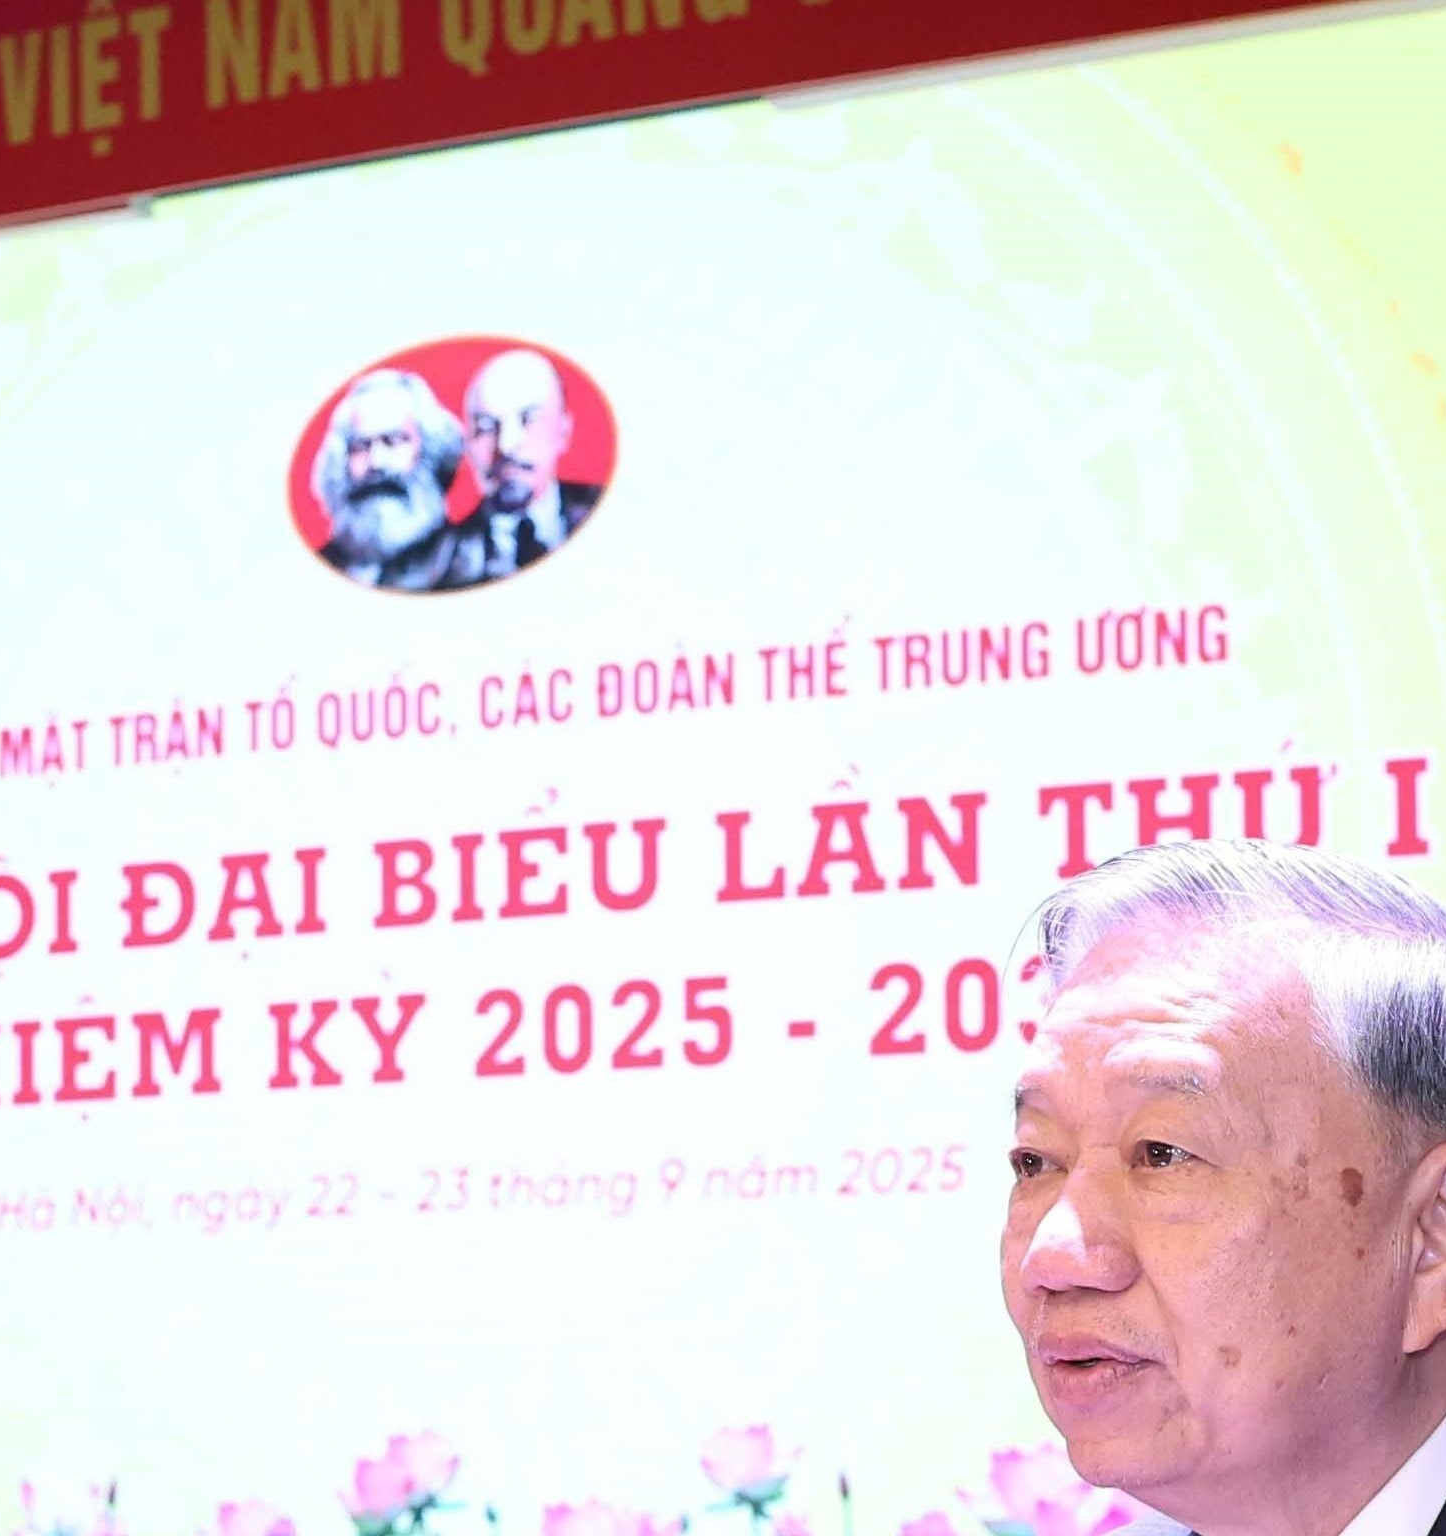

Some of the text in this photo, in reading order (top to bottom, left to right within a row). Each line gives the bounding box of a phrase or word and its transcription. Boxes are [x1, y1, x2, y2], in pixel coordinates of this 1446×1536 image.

[206, 0, 403, 110] NAM
[108, 696, 225, 777] TRẬN
[478, 659, 575, 730] CÁC
[596, 641, 737, 719] ĐOÀN
[873, 619, 1052, 693] TRUNG
[1074, 602, 1230, 686] ƯƠNG
[122, 847, 327, 961] ĐẠI
[373, 785, 668, 930] BIỂU
[716, 763, 987, 904] LẦN
[1386, 757, 1429, 857] I
[268, 969, 426, 1089] KỲ
[474, 976, 734, 1078] 2025
[305, 1169, 359, 1219] 22
[415, 1163, 471, 1214] 23
[659, 1156, 686, 1202] 9
[834, 1141, 969, 1198] 2025
